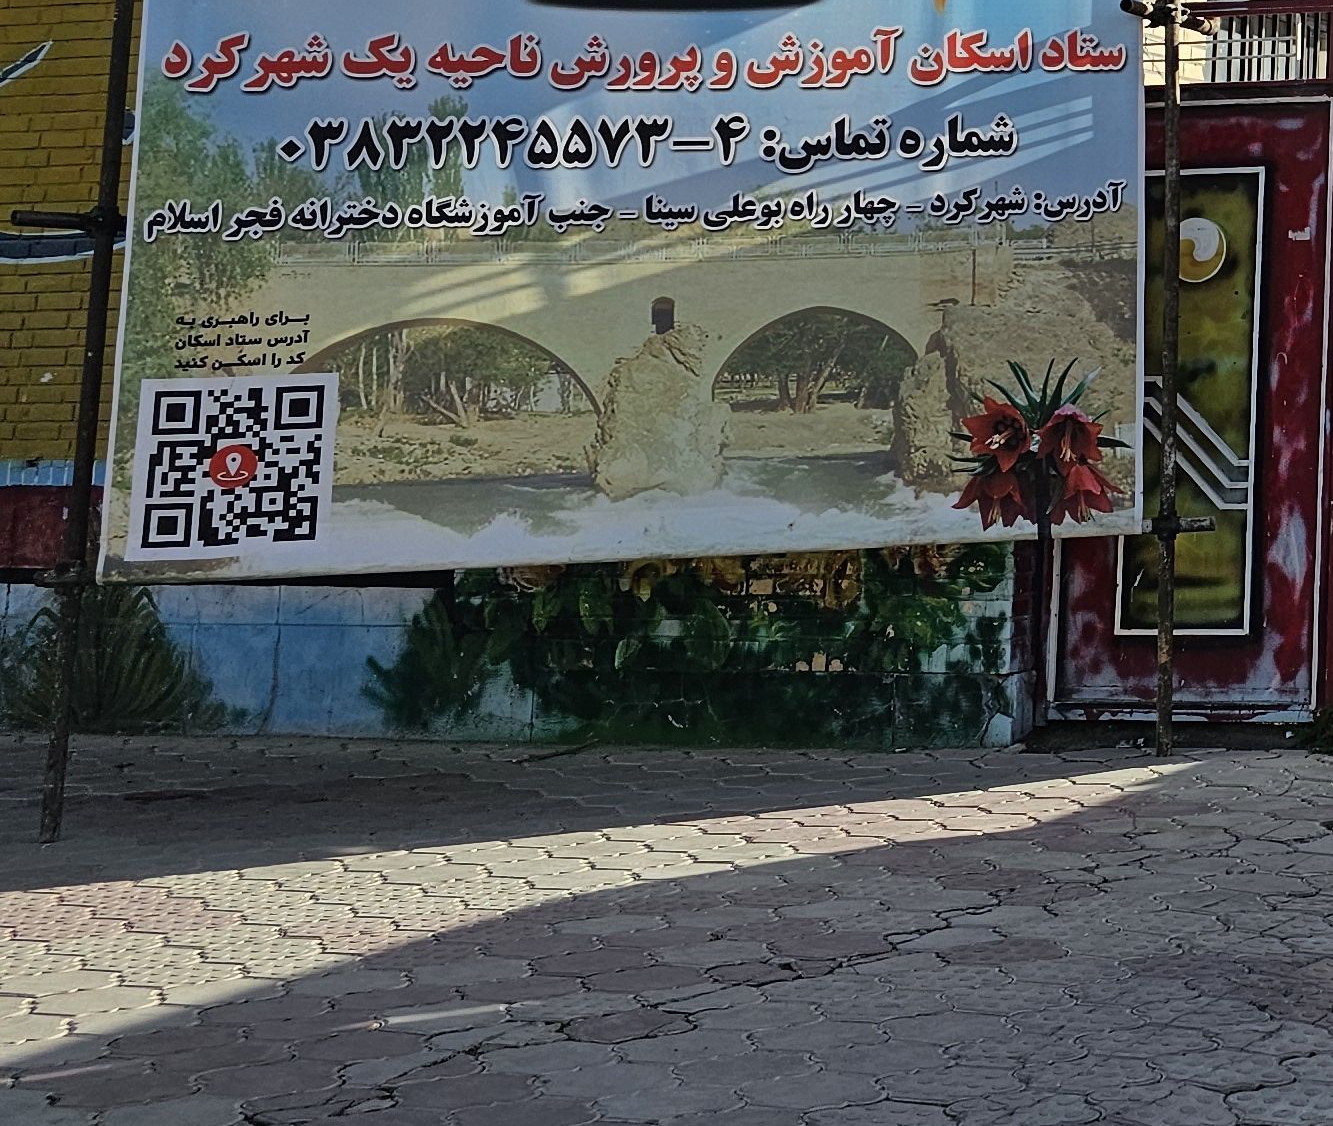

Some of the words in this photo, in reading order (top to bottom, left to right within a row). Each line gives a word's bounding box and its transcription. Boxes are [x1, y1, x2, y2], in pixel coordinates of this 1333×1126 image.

[340, 32, 415, 90] یک
[427, 30, 540, 90] ناحیه
[549, 31, 703, 89] پرورش
[710, 47, 736, 89] و
[745, 28, 902, 88] آموزش
[909, 29, 1031, 84] اسکان
[1038, 31, 1126, 71] ستاد
[759, 115, 891, 174] تماس:
[899, 111, 1018, 169] شماره
[143, 198, 222, 242] اسلام
[222, 196, 286, 241] فجر
[289, 196, 402, 238] دخترانه
[404, 193, 545, 235] آموزشگاه
[545, 200, 613, 235] جنب
[643, 193, 698, 232] سینا
[702, 192, 783, 231] بوعلی
[1033, 179, 1128, 221] آدرس:
[175, 315, 196, 328] به
[202, 311, 260, 328] راهبری
[265, 311, 310, 325] برای
[266, 329, 310, 347] آدرس
[174, 334, 221, 350] اسکان
[225, 333, 263, 346] ستاد
[271, 353, 282, 366] را
[286, 352, 306, 365] کد
[174, 355, 208, 370] کنید
[211, 352, 266, 370] اسکن
